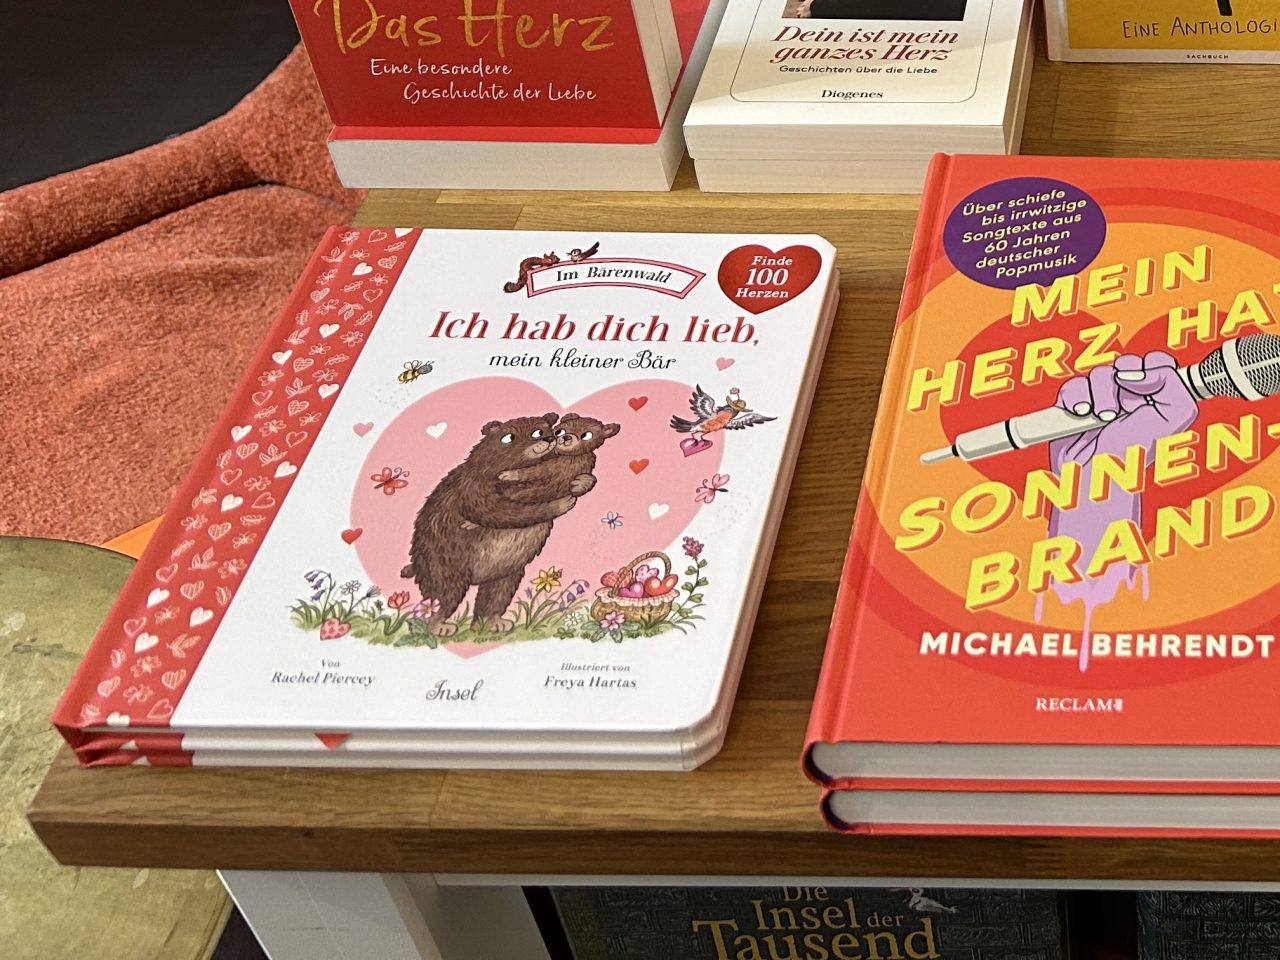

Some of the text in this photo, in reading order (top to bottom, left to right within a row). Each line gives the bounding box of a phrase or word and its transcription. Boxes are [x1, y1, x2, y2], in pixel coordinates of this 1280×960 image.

[370, 58, 512, 76] Eine besondere
[403, 82, 597, 104] Geschichte der Liebe
[963, 188, 1066, 217] Über schiefe
[981, 198, 1088, 227] bis irrwitzige
[962, 212, 1082, 244] Songtexte aus
[985, 228, 1071, 254] 60 Jahren
[752, 255, 793, 267] Finde
[976, 244, 1061, 271] deutscher
[996, 253, 1077, 280] Popmusik
[555, 265, 673, 285] Im Bärenwald
[744, 267, 789, 286] 100
[1011, 244, 1213, 327] MEIN
[735, 288, 790, 299] Herzen
[428, 311, 760, 347] Ich hab dich lieb,
[489, 347, 677, 371] mein kleiner Bär
[906, 322, 1122, 413] HERZ
[965, 484, 1277, 612] BRAND
[920, 630, 1275, 658] MICHAEL BEHRENDT
[321, 658, 341, 669] Von
[560, 661, 631, 673] Illustriert von
[271, 670, 376, 688] Rachel Piercey
[425, 678, 484, 703] Insel
[544, 675, 638, 691] Freya Hartas
[1035, 697, 1112, 713] RECLAM
[782, 886, 828, 903] Die
[750, 898, 905, 931] Insel der
[692, 917, 942, 960] Tausend
